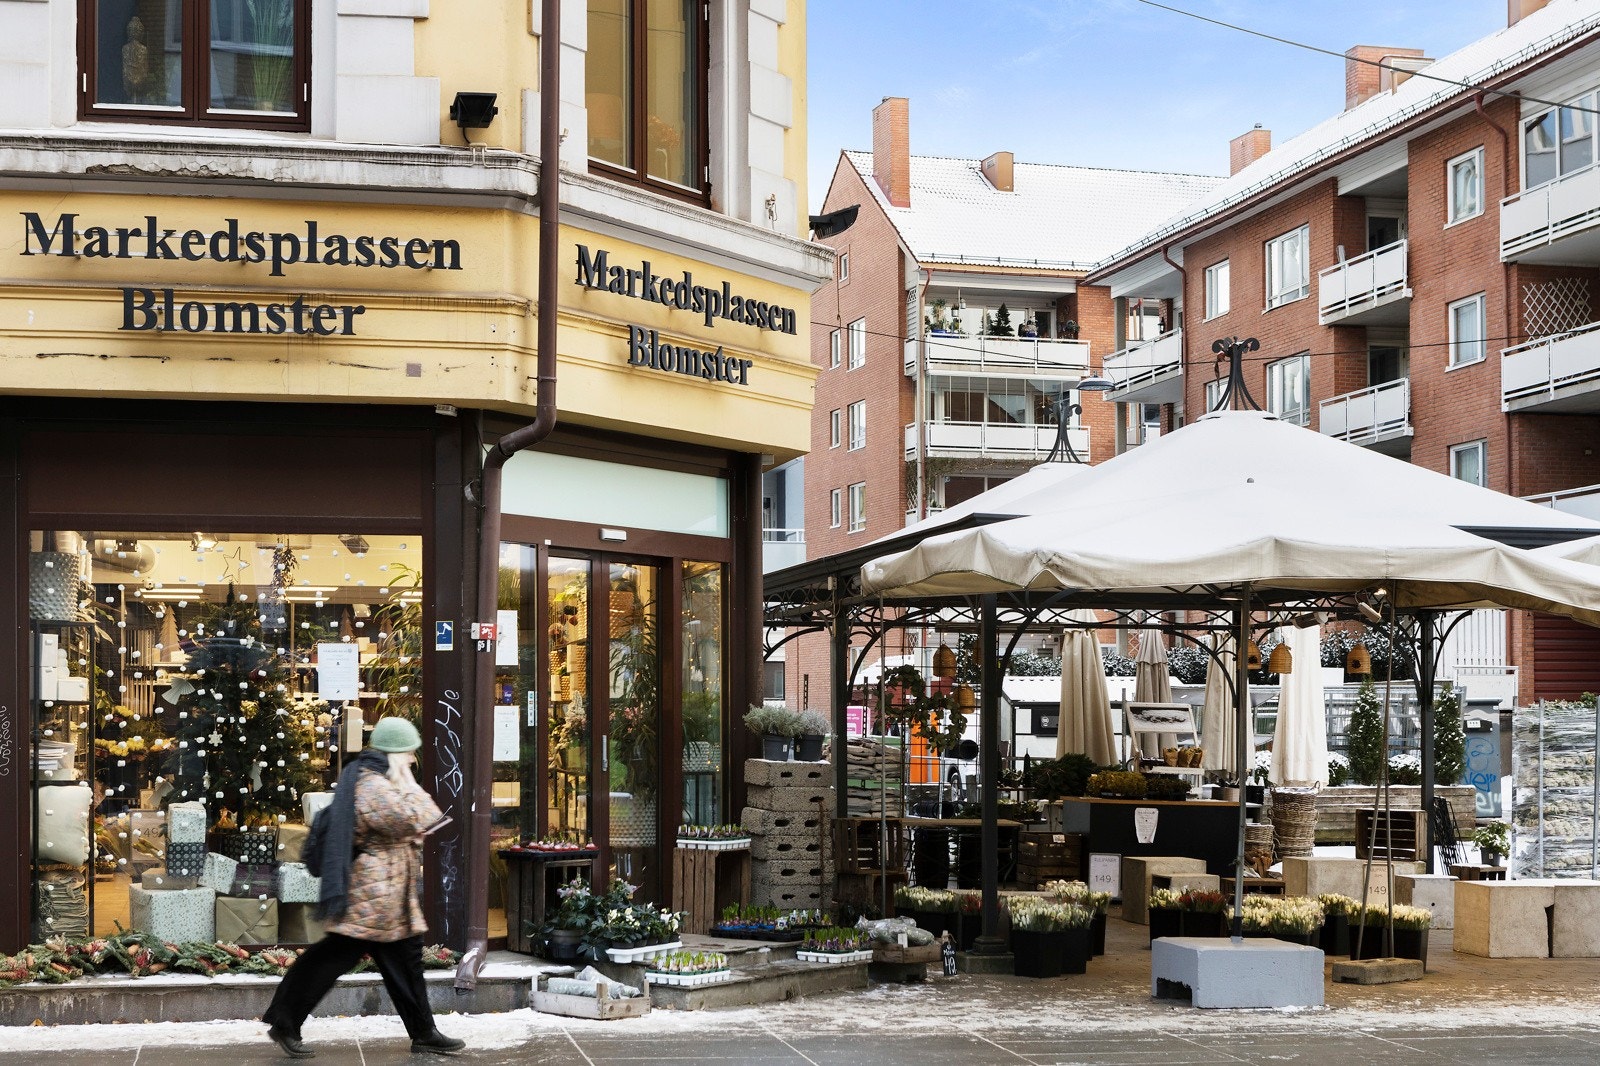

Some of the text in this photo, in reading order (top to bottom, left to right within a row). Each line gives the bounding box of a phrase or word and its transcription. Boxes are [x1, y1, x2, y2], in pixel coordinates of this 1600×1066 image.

[20, 213, 463, 277] Markedsplassen
[119, 287, 366, 337] Blomster
[575, 244, 797, 336] Markedsplassen
[627, 324, 754, 387] Blomster
